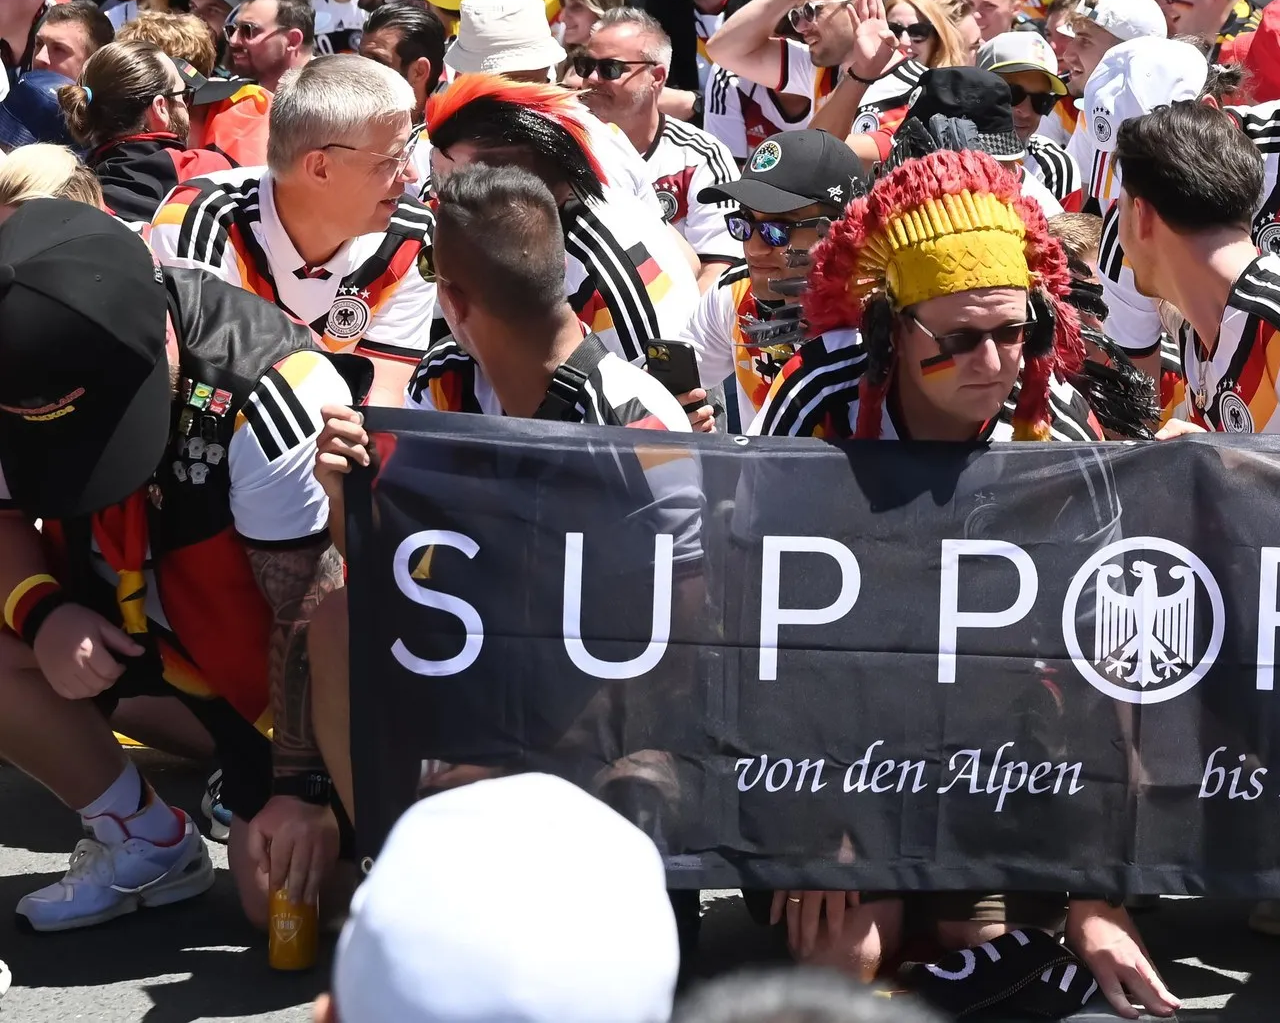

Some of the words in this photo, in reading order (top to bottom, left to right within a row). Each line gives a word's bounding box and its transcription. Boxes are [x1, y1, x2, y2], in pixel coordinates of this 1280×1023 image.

[734, 753, 828, 794] von
[843, 739, 928, 794] den
[937, 741, 1085, 812] Alpen
[1198, 746, 1268, 802] bis
